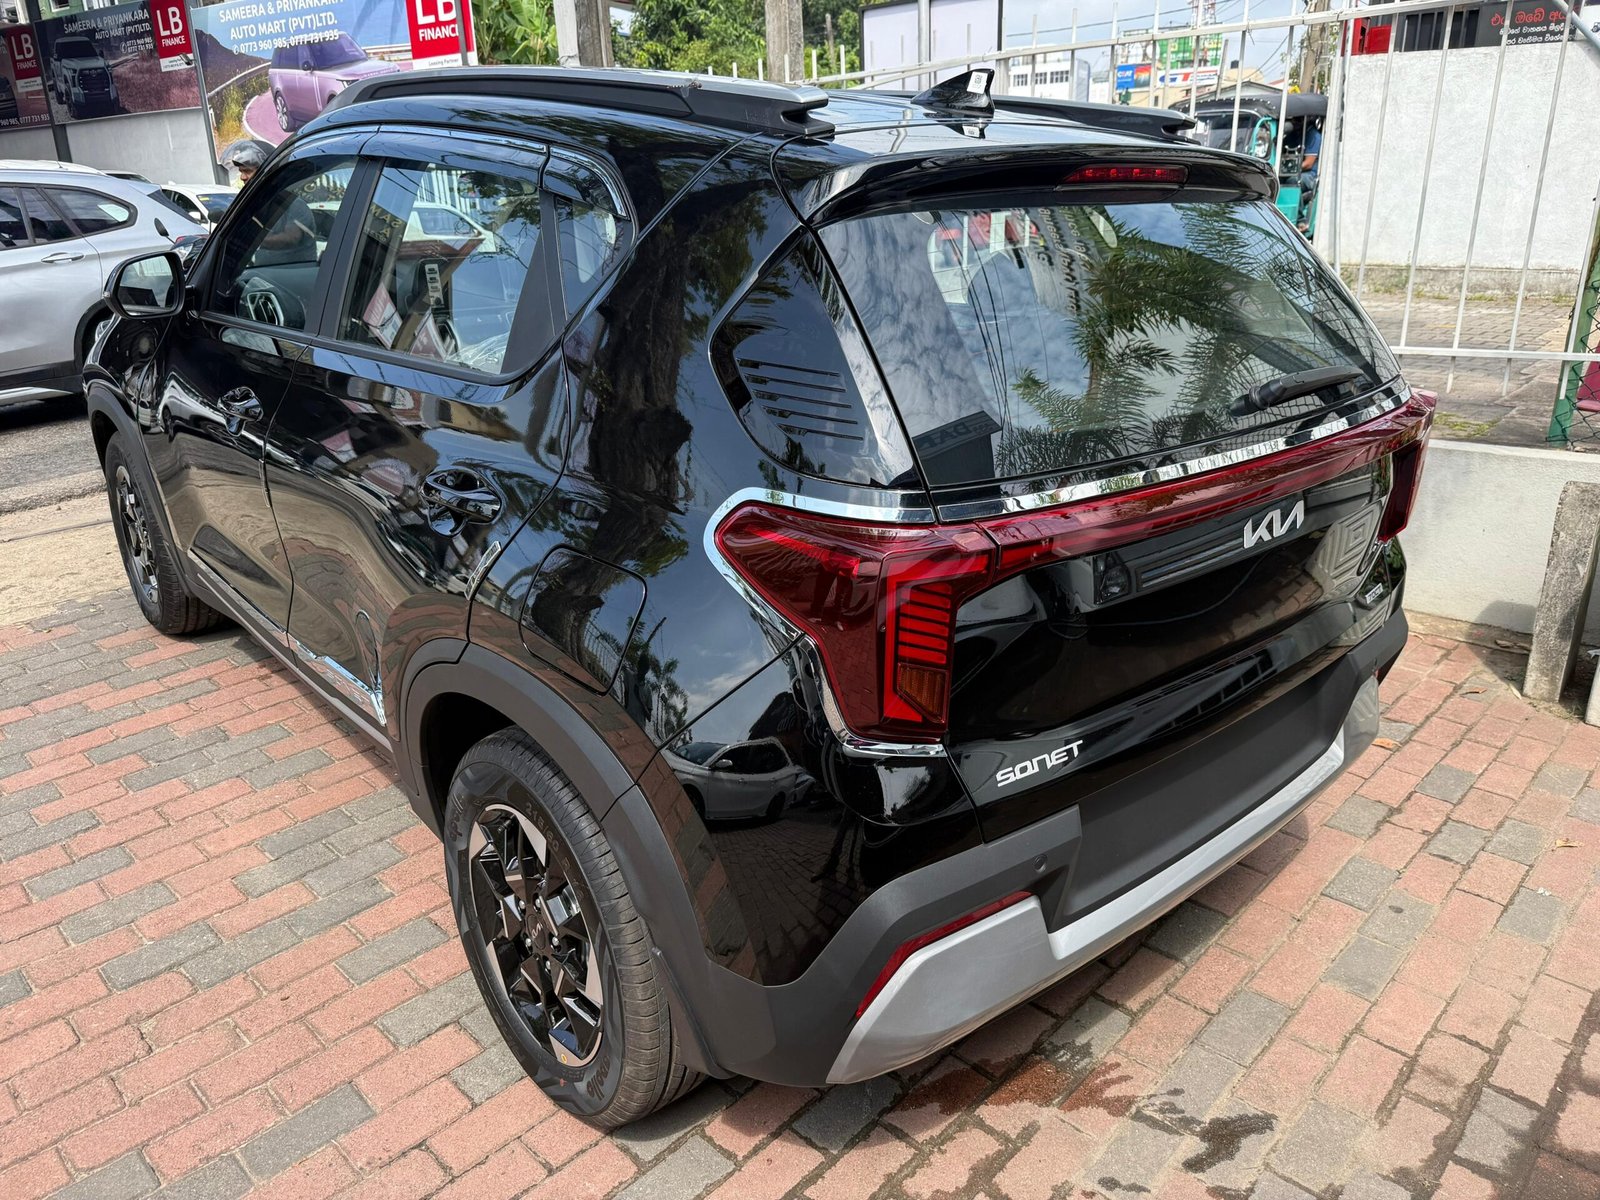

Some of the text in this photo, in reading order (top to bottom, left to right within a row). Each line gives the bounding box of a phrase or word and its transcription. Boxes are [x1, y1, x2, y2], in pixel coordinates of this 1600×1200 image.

[64, 20, 97, 34] SAMEERA
[103, 9, 150, 27] PRIYANKARA
[156, 6, 183, 36] LB
[218, 6, 264, 22] SAMEERA
[267, 3, 275, 14] &
[95, 29, 110, 40] AUTO
[110, 27, 125, 38] MART
[162, 36, 186, 47] FINANCE
[230, 24, 256, 40] AUTO
[258, 20, 286, 36] MART
[240, 42, 258, 54] 0773
[258, 40, 272, 50] 960
[325, 29, 340, 41] 935
[11, 33, 34, 60] LB
[17, 60, 37, 70] FINANCE
[1244, 500, 1304, 549] KIA
[996, 740, 1083, 787] SONET
